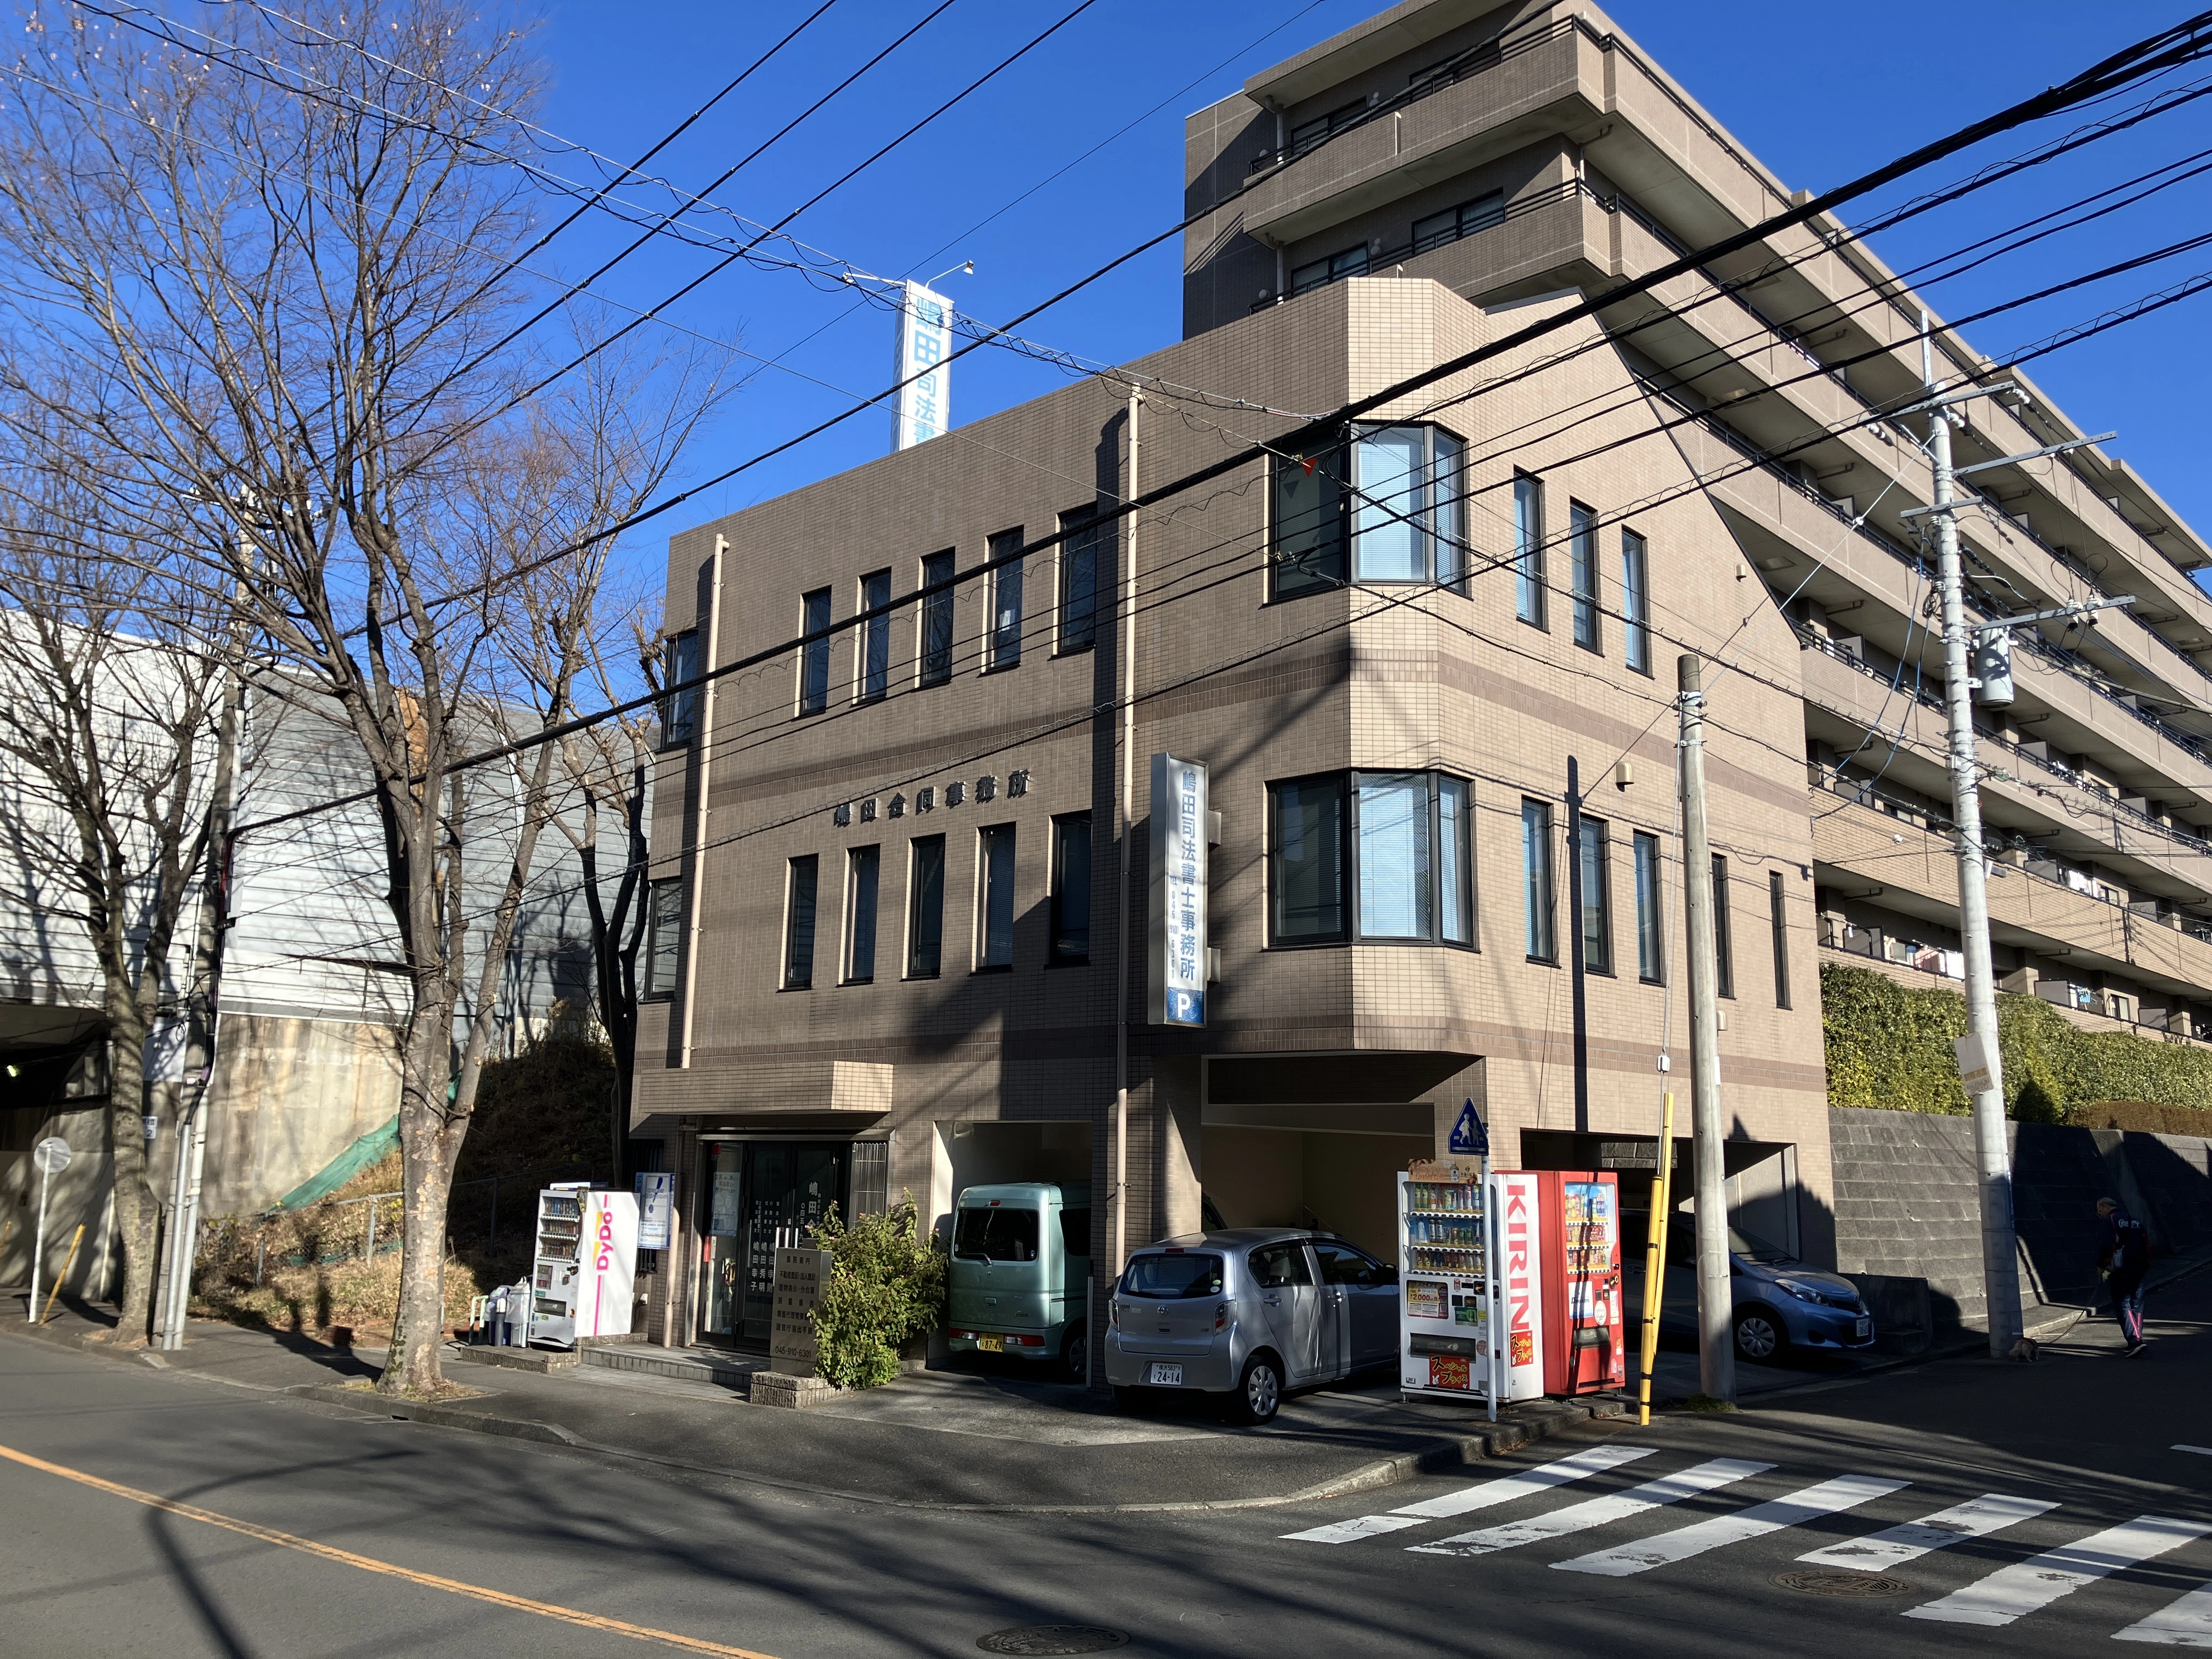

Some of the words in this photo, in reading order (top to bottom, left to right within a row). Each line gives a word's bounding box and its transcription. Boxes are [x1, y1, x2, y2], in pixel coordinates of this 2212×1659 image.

[1169, 875, 1178, 886] TEL
[1180, 770, 1197, 981] 嶋田司法書士事務所
[1177, 992, 1190, 1018] P
[596, 1211, 614, 1270] DyDo
[1507, 1184, 1530, 1330] KIRIN
[775, 1346, 811, 1358] 045-910-6301
[1431, 1355, 1468, 1372] スペシャル
[1157, 1371, 1180, 1384] 24-14
[1441, 1371, 1468, 1384] プライス
